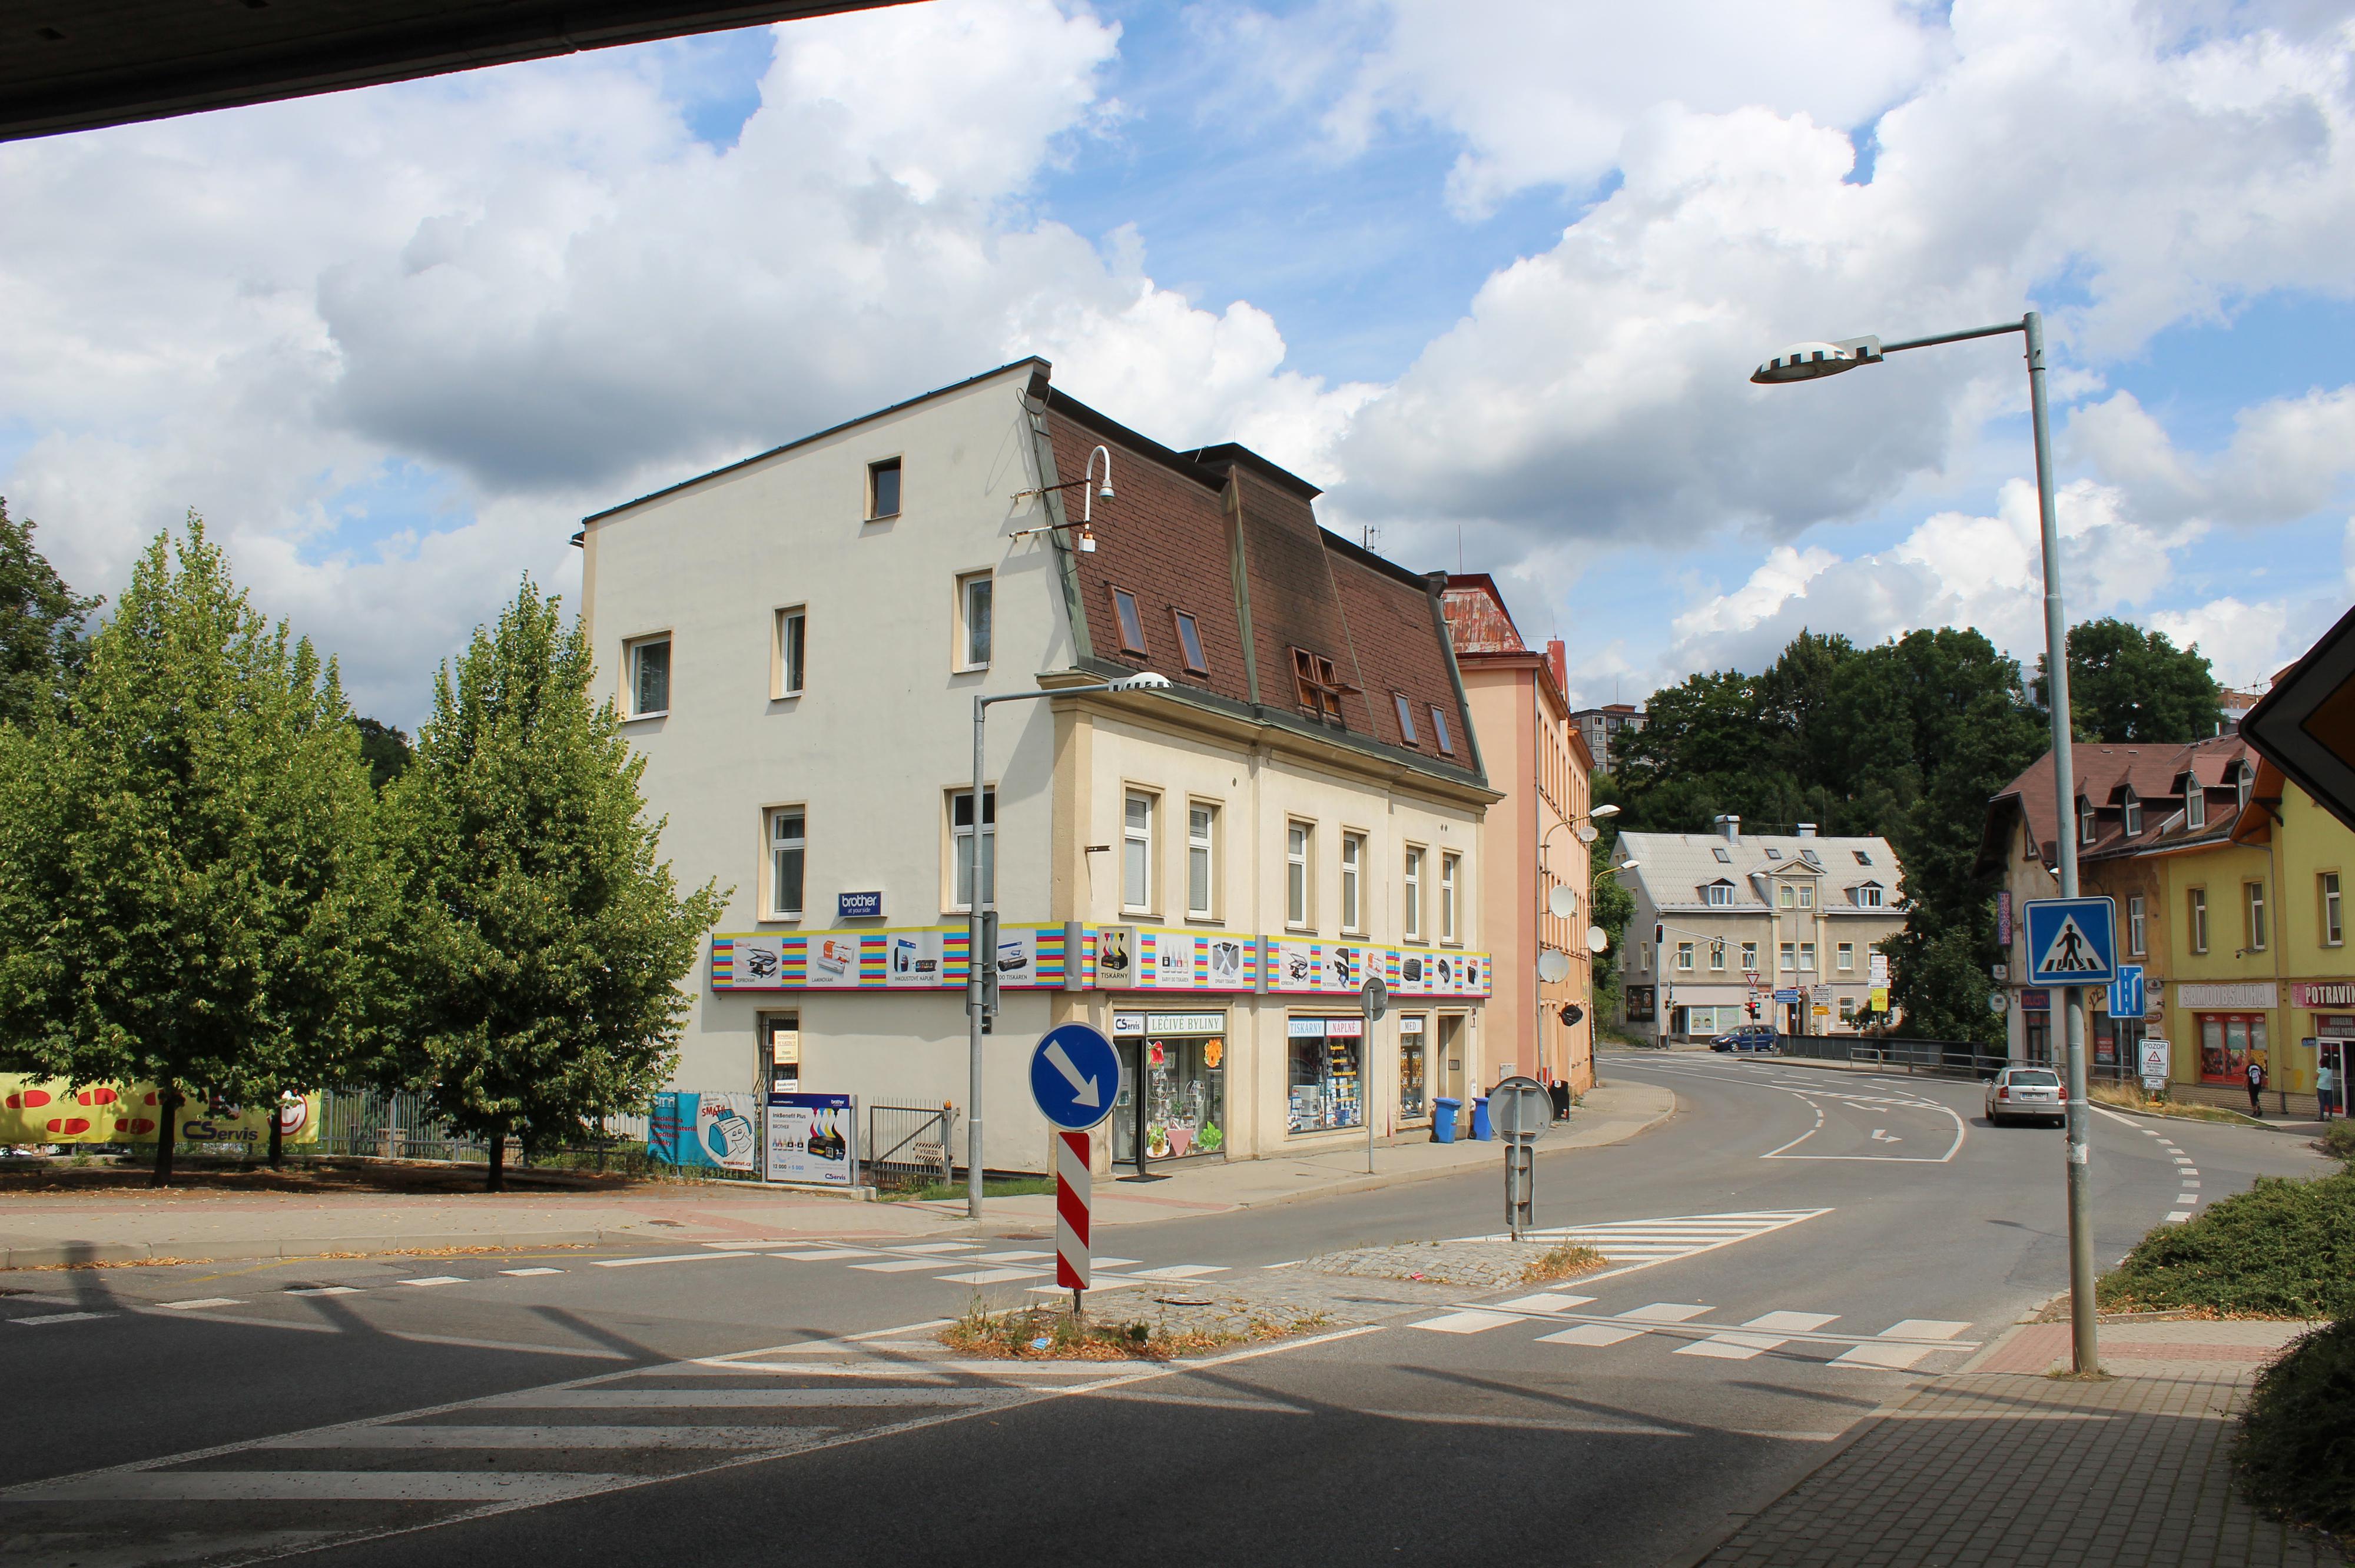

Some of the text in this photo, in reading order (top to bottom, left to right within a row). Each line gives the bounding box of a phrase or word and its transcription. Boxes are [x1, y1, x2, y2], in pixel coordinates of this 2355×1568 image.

[842, 894, 877, 907] brother
[2184, 984, 2266, 1006] SAMOOBSLUHA
[1116, 1018, 1140, 1030] CServis
[1152, 1015, 1219, 1031] LÉČIVÉ BYLINY
[1290, 1021, 1322, 1034] TISKÁRNY
[1332, 1021, 1355, 1033] NÁPLNĚ
[1405, 1022, 1416, 1031] MED
[183, 1121, 258, 1141] CServis
